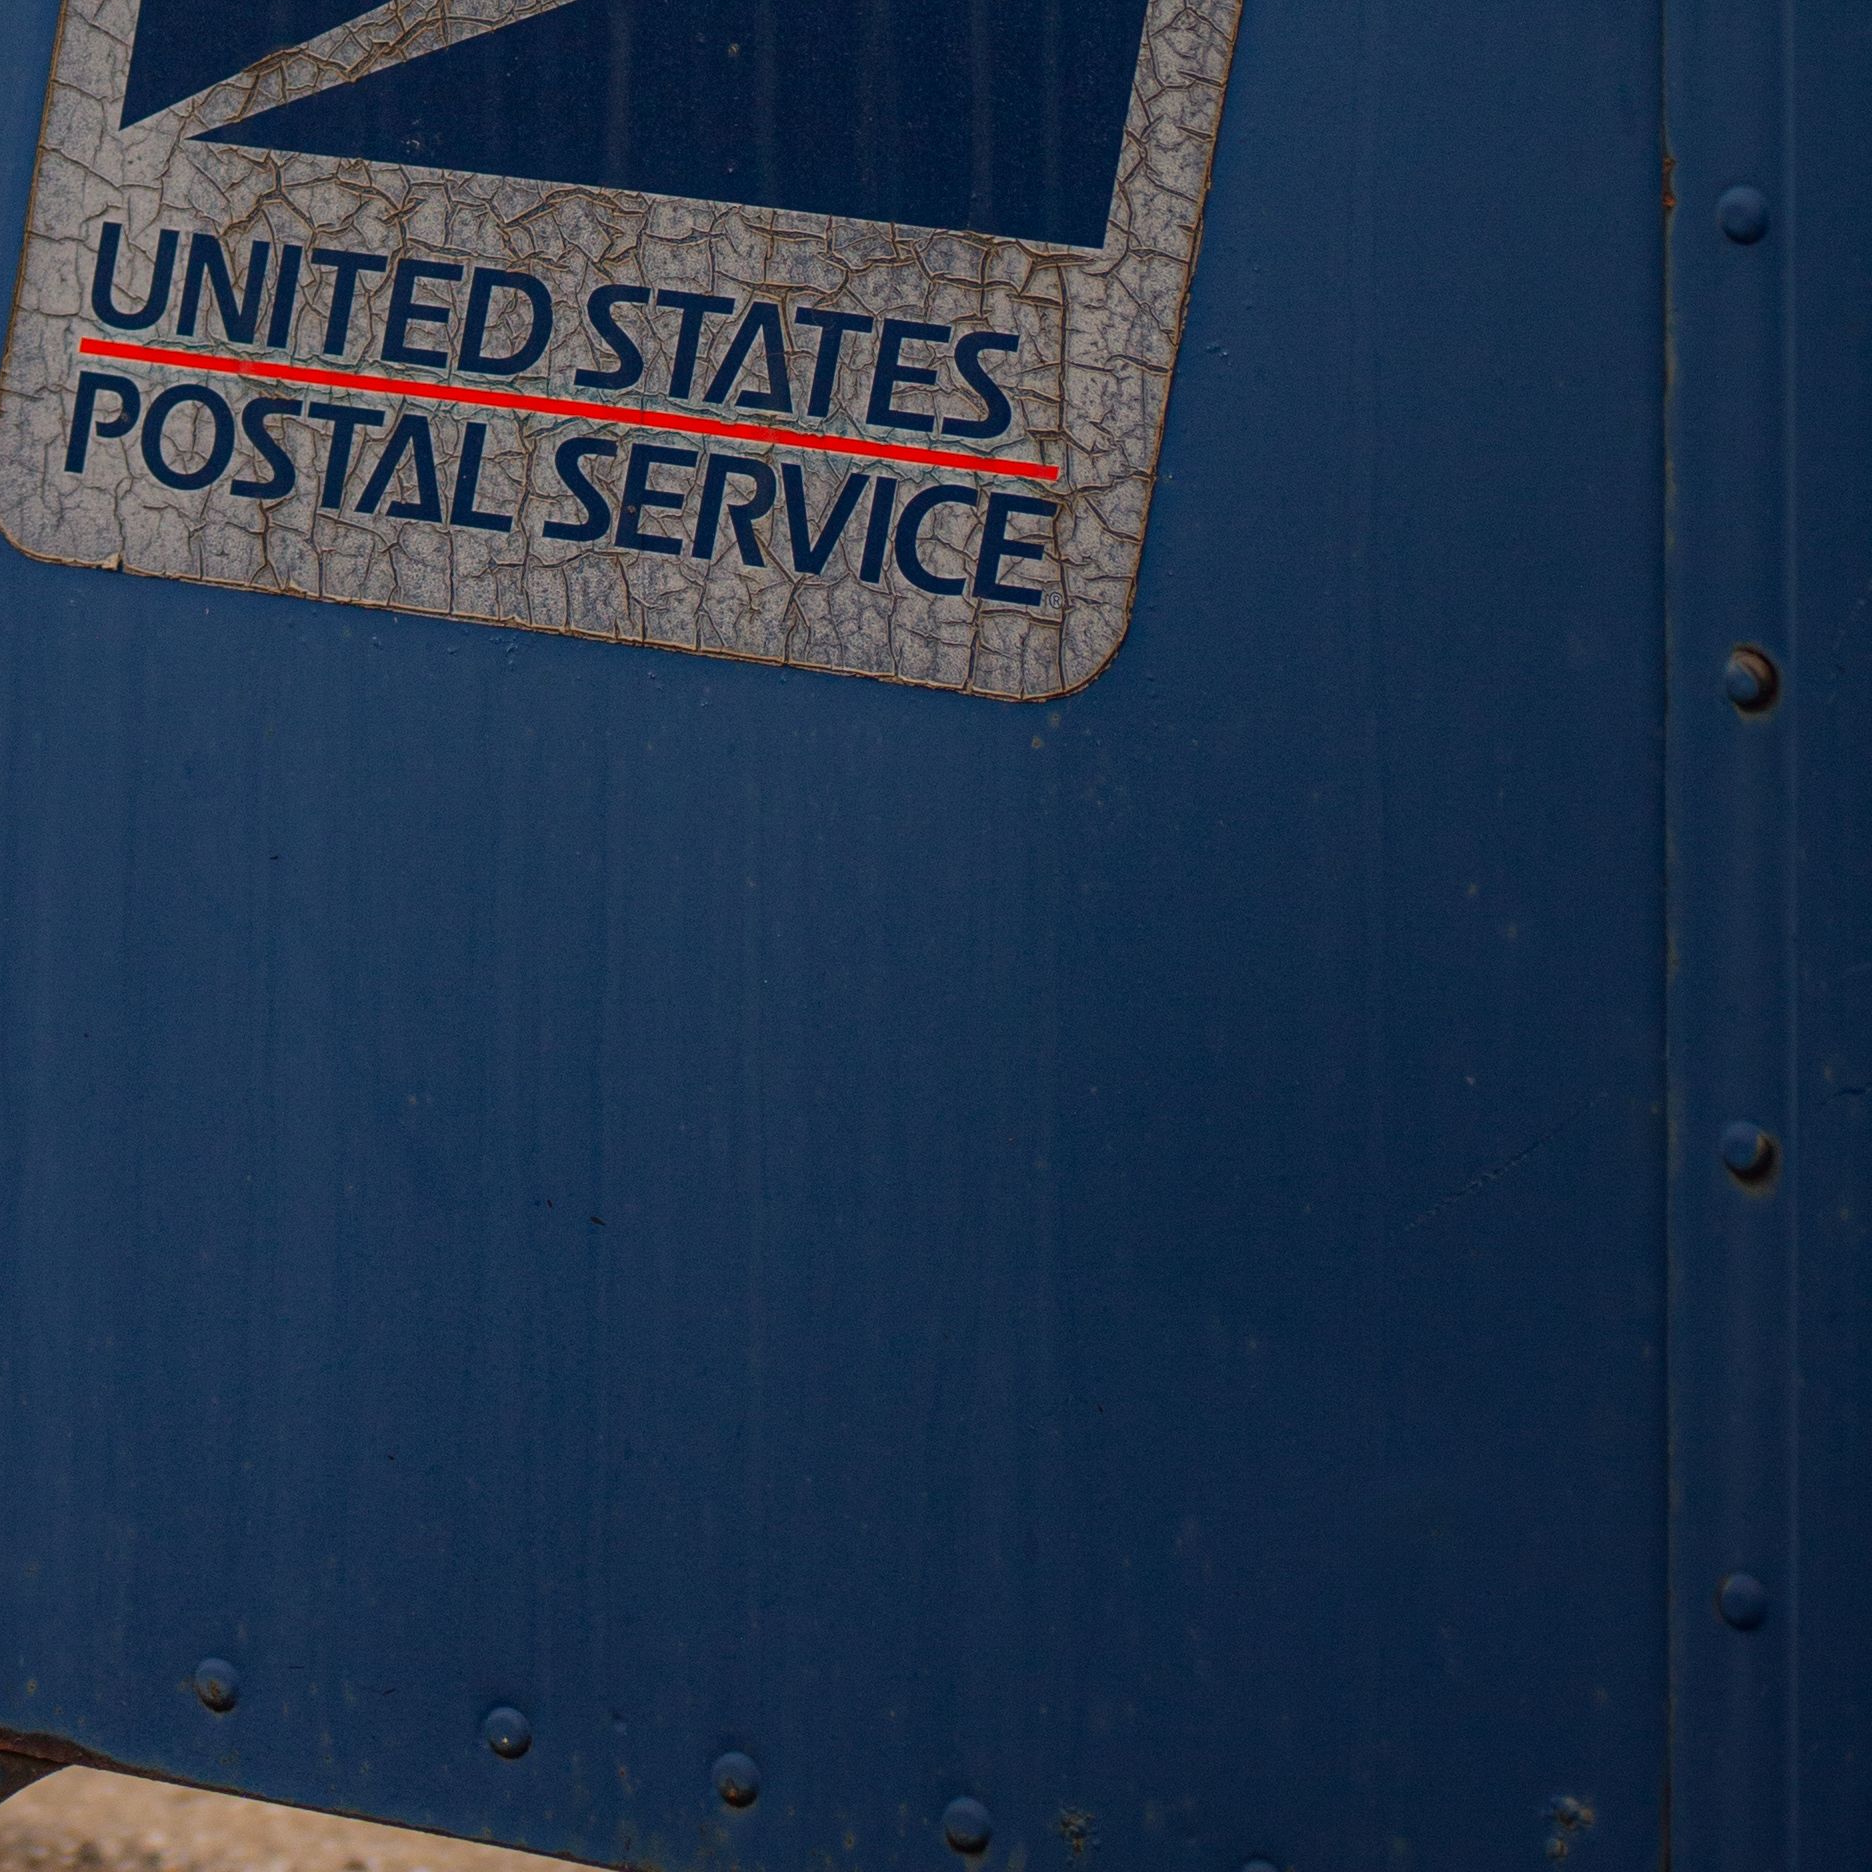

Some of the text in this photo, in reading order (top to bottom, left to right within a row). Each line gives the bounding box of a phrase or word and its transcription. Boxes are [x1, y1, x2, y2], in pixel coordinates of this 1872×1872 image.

[92, 223, 1020, 439] UNITED STATES
[65, 371, 513, 533] POSTAL
